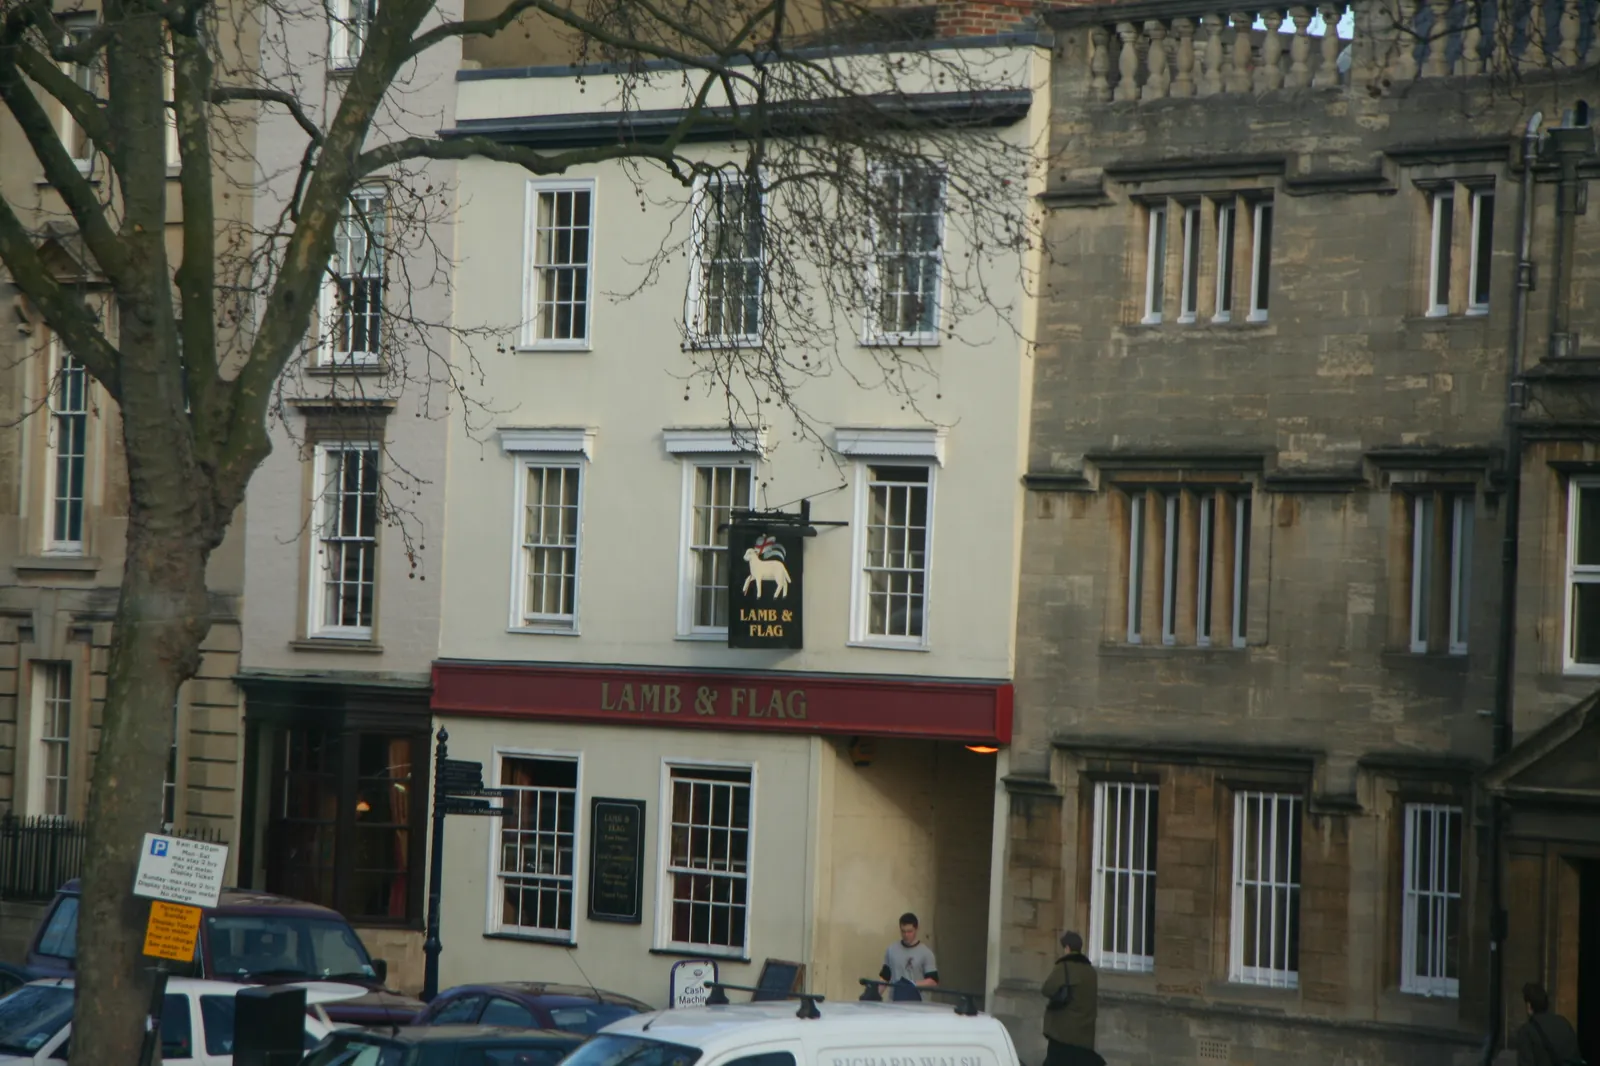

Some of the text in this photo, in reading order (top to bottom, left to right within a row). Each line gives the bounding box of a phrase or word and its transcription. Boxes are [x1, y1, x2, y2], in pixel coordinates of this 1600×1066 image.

[740, 608, 793, 622] LAMB &
[749, 624, 783, 637] FLAG
[601, 682, 807, 719] LAMB & FLAG
[154, 841, 167, 856] P
[684, 986, 705, 995] Cash
[678, 995, 707, 1005] Machin
